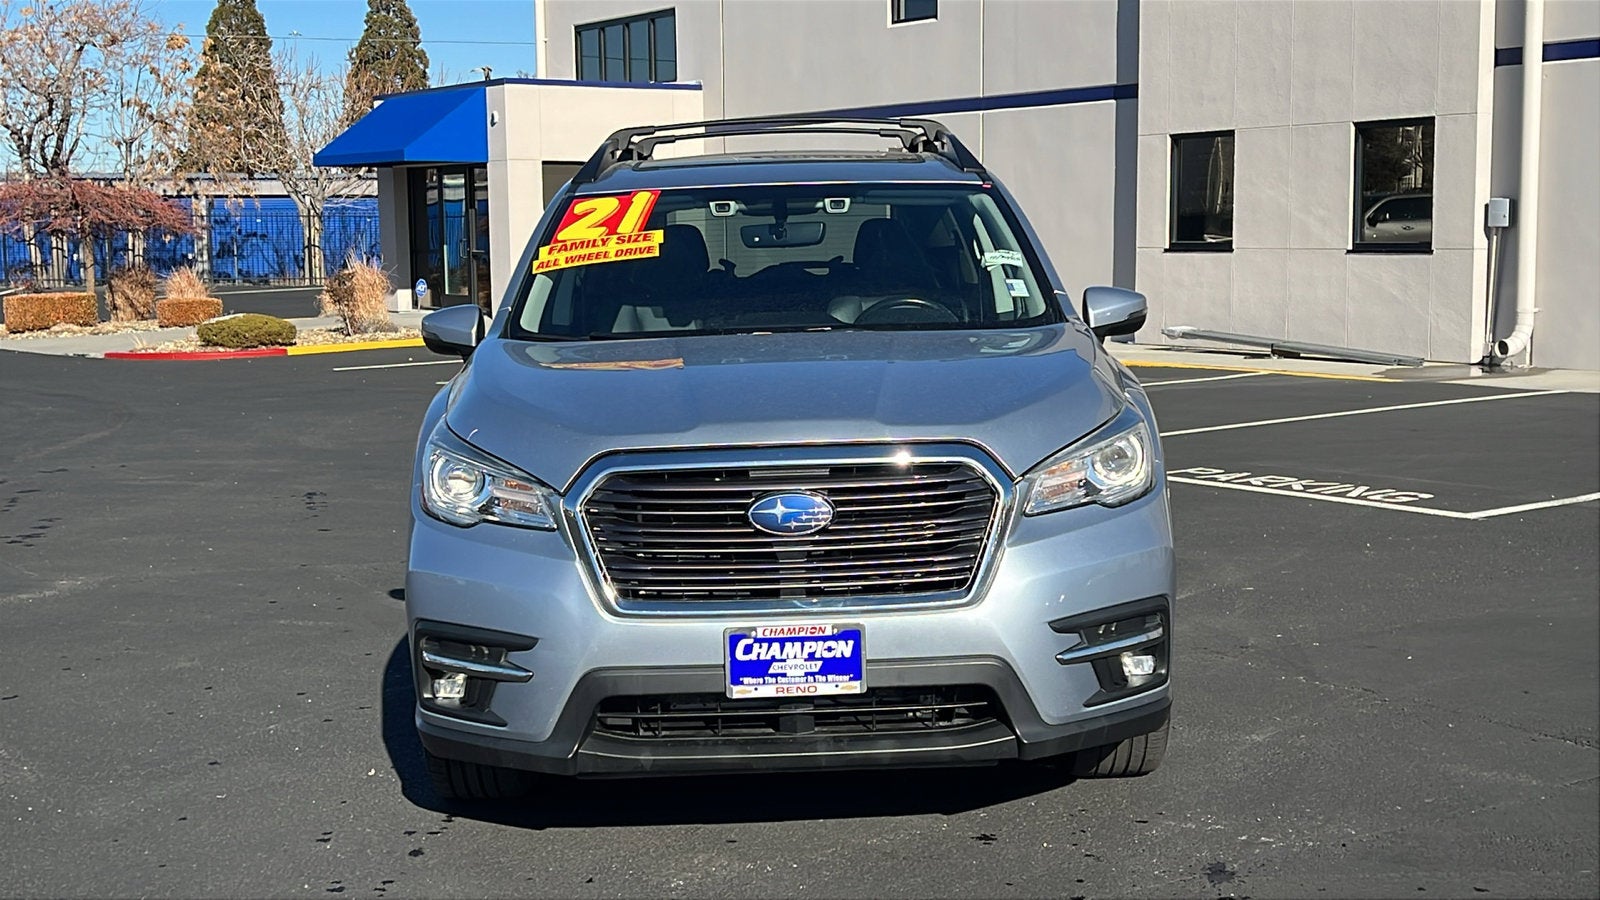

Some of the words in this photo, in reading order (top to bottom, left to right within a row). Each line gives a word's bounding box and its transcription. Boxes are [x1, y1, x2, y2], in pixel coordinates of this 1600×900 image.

[557, 191, 655, 240] 21
[547, 237, 612, 256] FAMILY
[616, 232, 655, 244] SIZE
[535, 259, 562, 271] ALL
[564, 251, 612, 264] WHEEL
[614, 246, 656, 258] DRIVE
[1166, 466, 1434, 502] PARKING
[762, 626, 827, 637] CHAMPION
[772, 663, 818, 671] CHEVROLET
[765, 676, 776, 684] The
[815, 674, 826, 683] The
[775, 685, 818, 695] RENO
